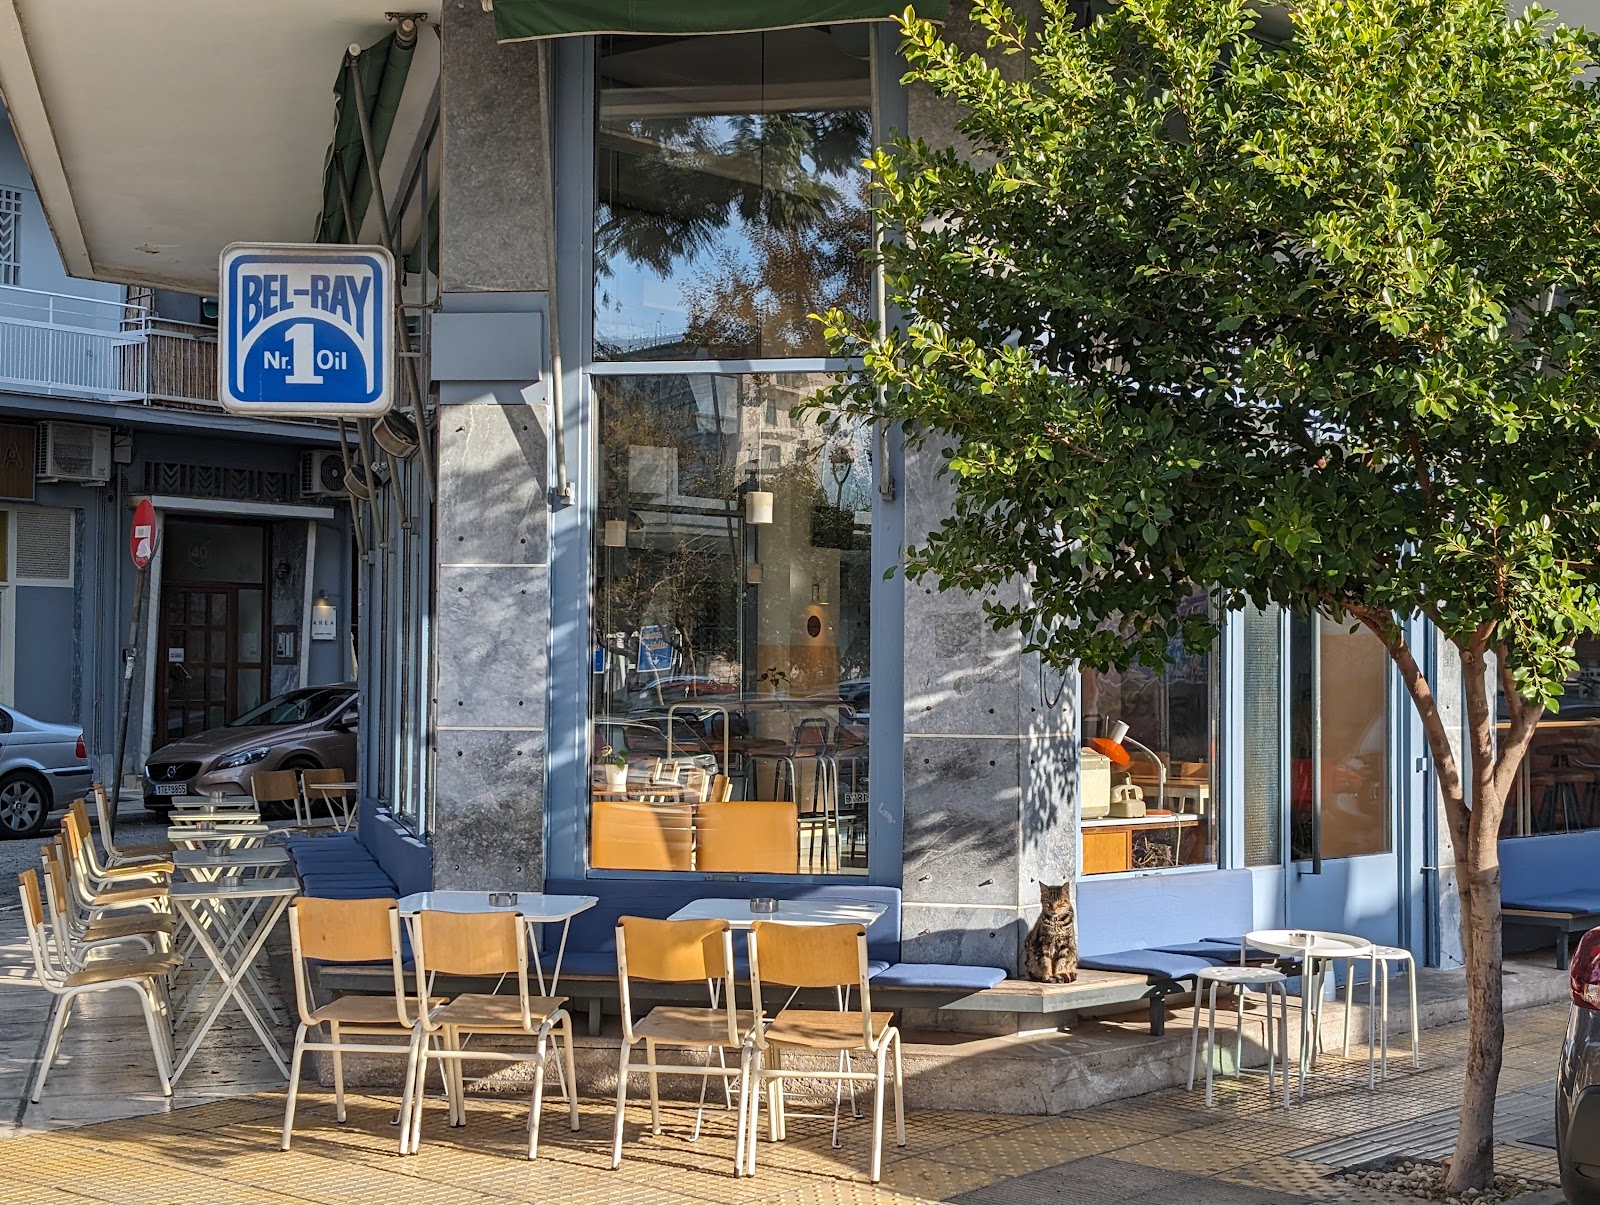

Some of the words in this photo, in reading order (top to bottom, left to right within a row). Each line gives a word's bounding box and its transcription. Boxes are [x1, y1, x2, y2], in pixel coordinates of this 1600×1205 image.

[242, 274, 372, 342] BEL-RAY
[263, 351, 291, 370] Nr.
[284, 323, 324, 384] 1
[316, 349, 347, 370] Oil
